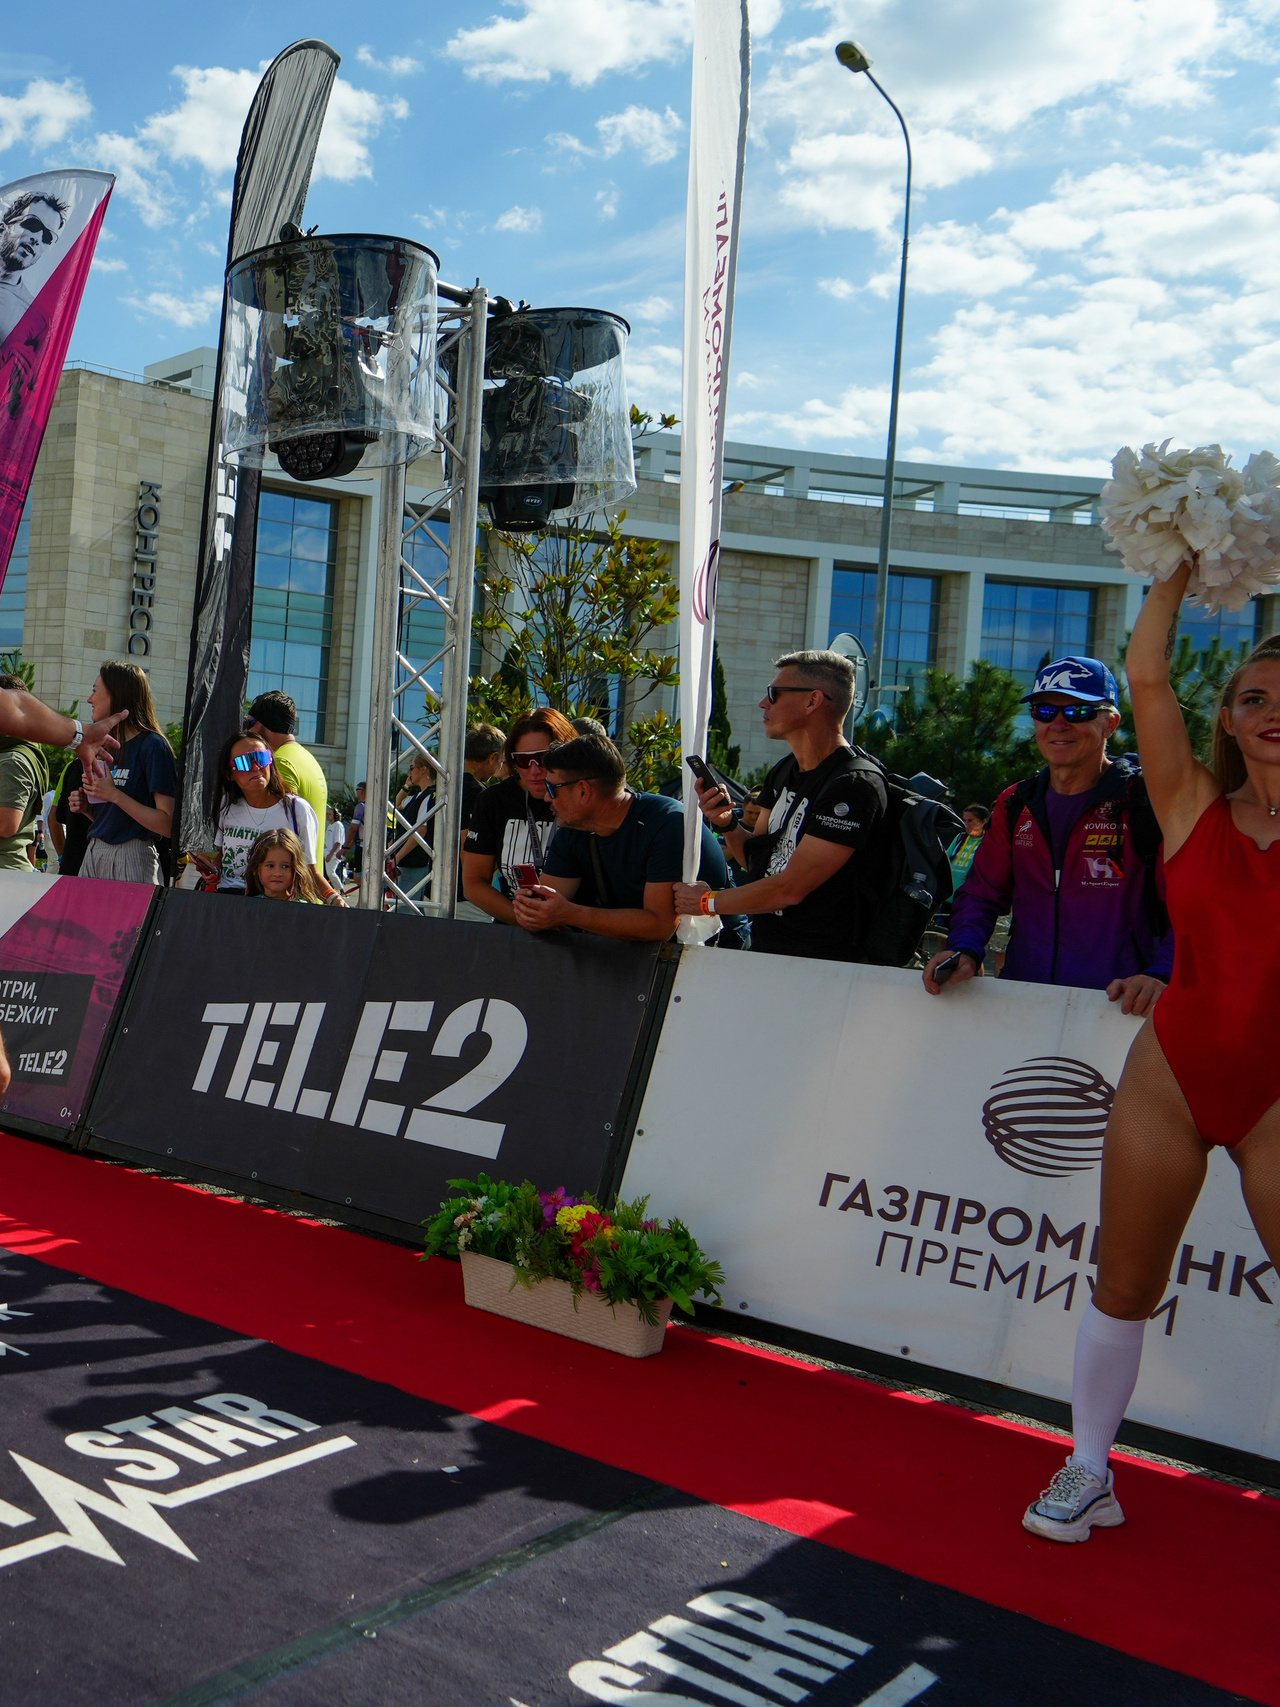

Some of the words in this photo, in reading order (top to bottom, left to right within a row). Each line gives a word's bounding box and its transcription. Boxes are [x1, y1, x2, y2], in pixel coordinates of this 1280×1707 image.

[793, 812, 803, 830] 2023
[815, 815, 861, 828] ГАЗПРОМБАНК
[18, 1050, 68, 1076] TELE2
[191, 998, 528, 1160] TELE2
[819, 1172, 1274, 1305] ГАЗПРОМНК
[65, 1392, 321, 1481] STAR
